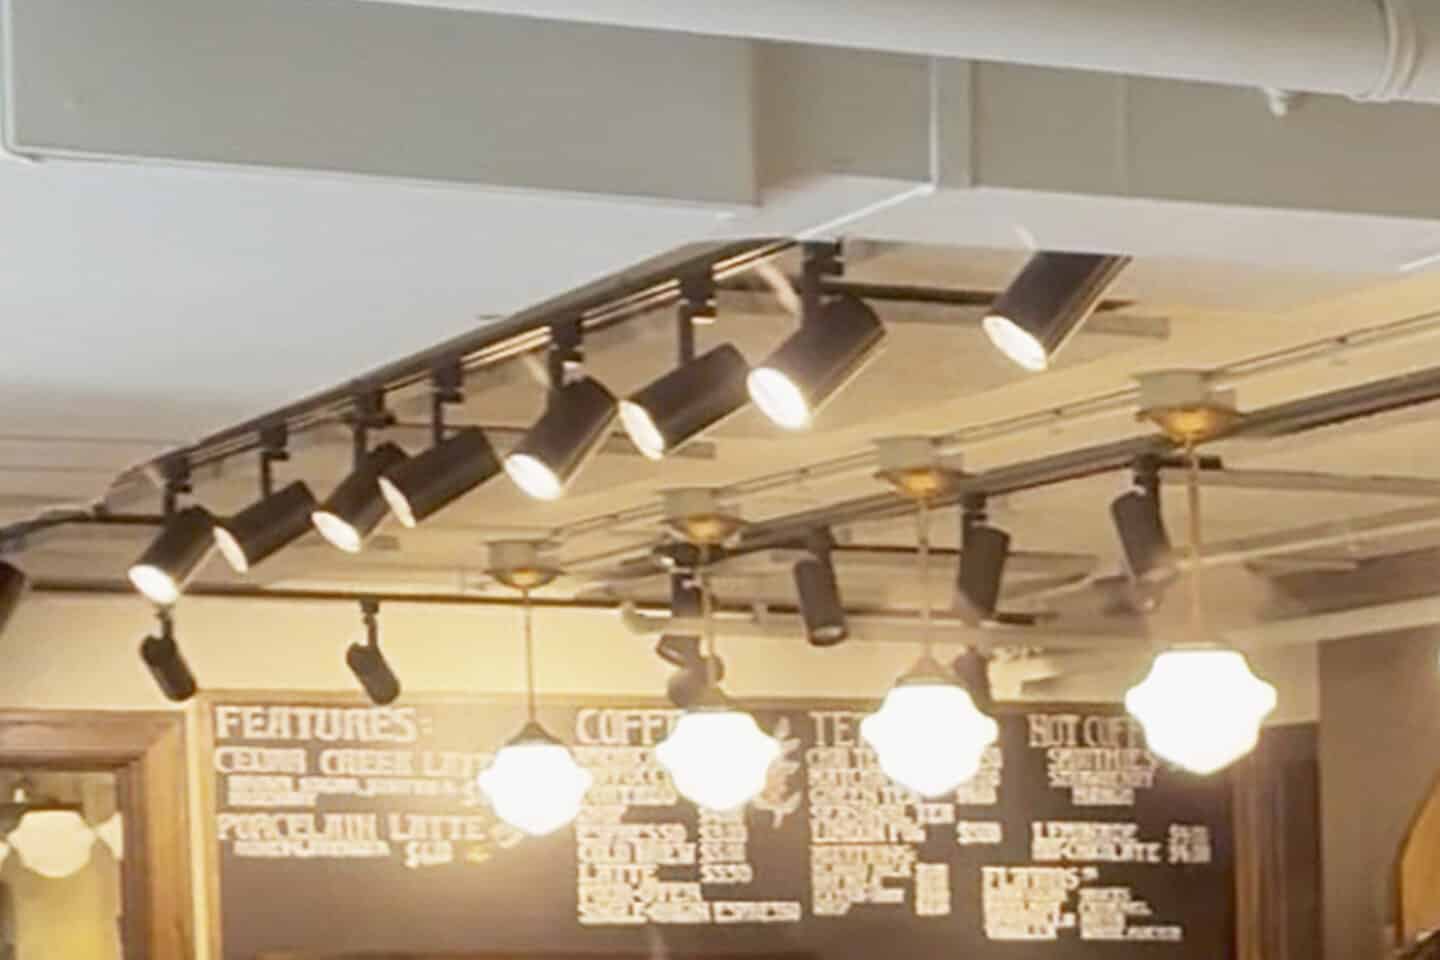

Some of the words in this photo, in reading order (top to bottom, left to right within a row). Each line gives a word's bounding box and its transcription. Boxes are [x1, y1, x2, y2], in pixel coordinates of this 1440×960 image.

[576, 709, 688, 746] COFF
[421, 751, 492, 777] LATT
[389, 813, 486, 841] LATTE
